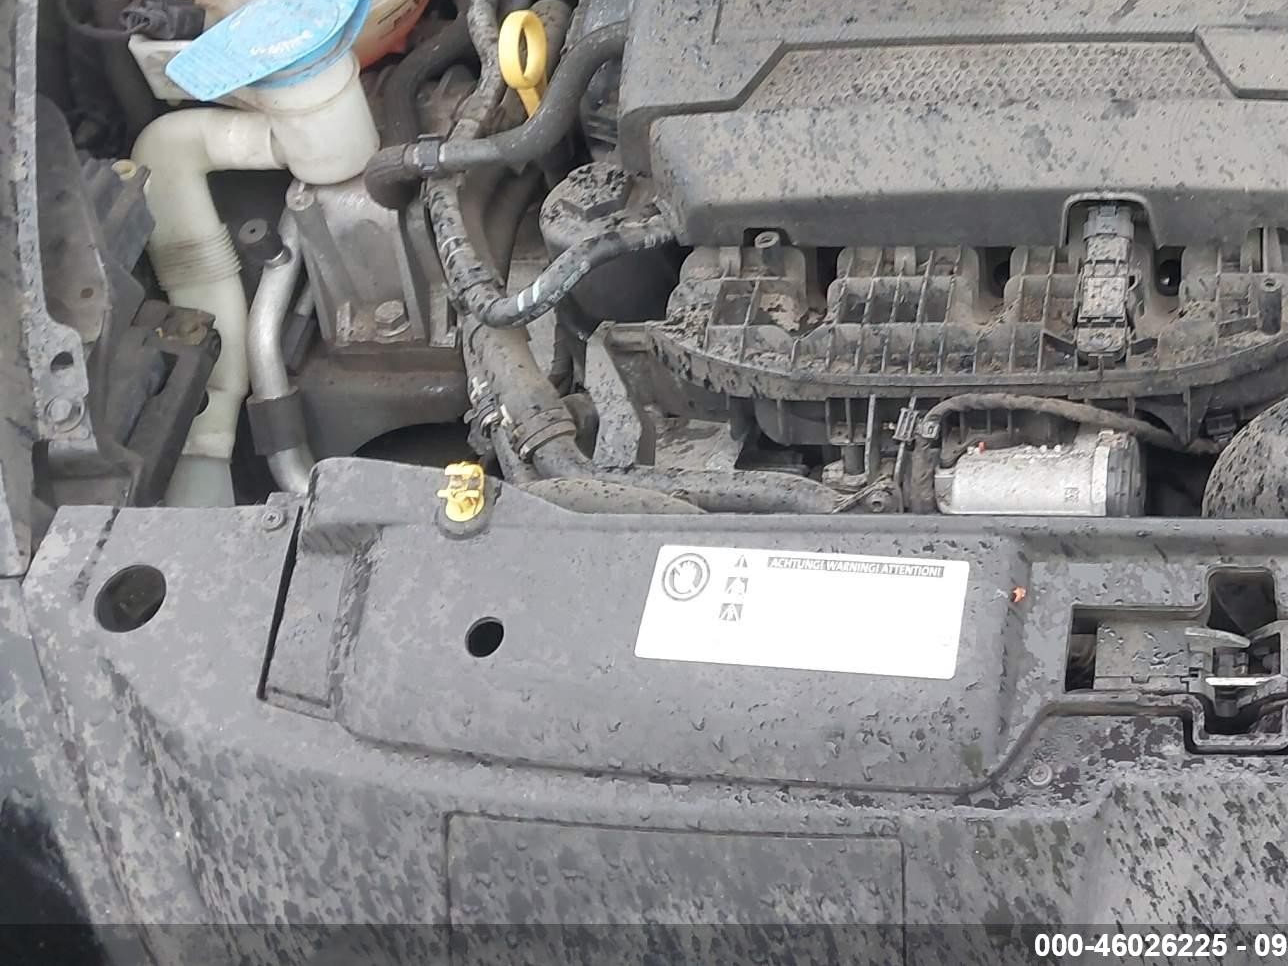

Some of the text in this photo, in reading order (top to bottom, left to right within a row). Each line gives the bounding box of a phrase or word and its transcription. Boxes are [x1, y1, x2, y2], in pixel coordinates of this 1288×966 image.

[770, 557, 943, 577] ACHTUNG! WARNING! ATTENTION!
